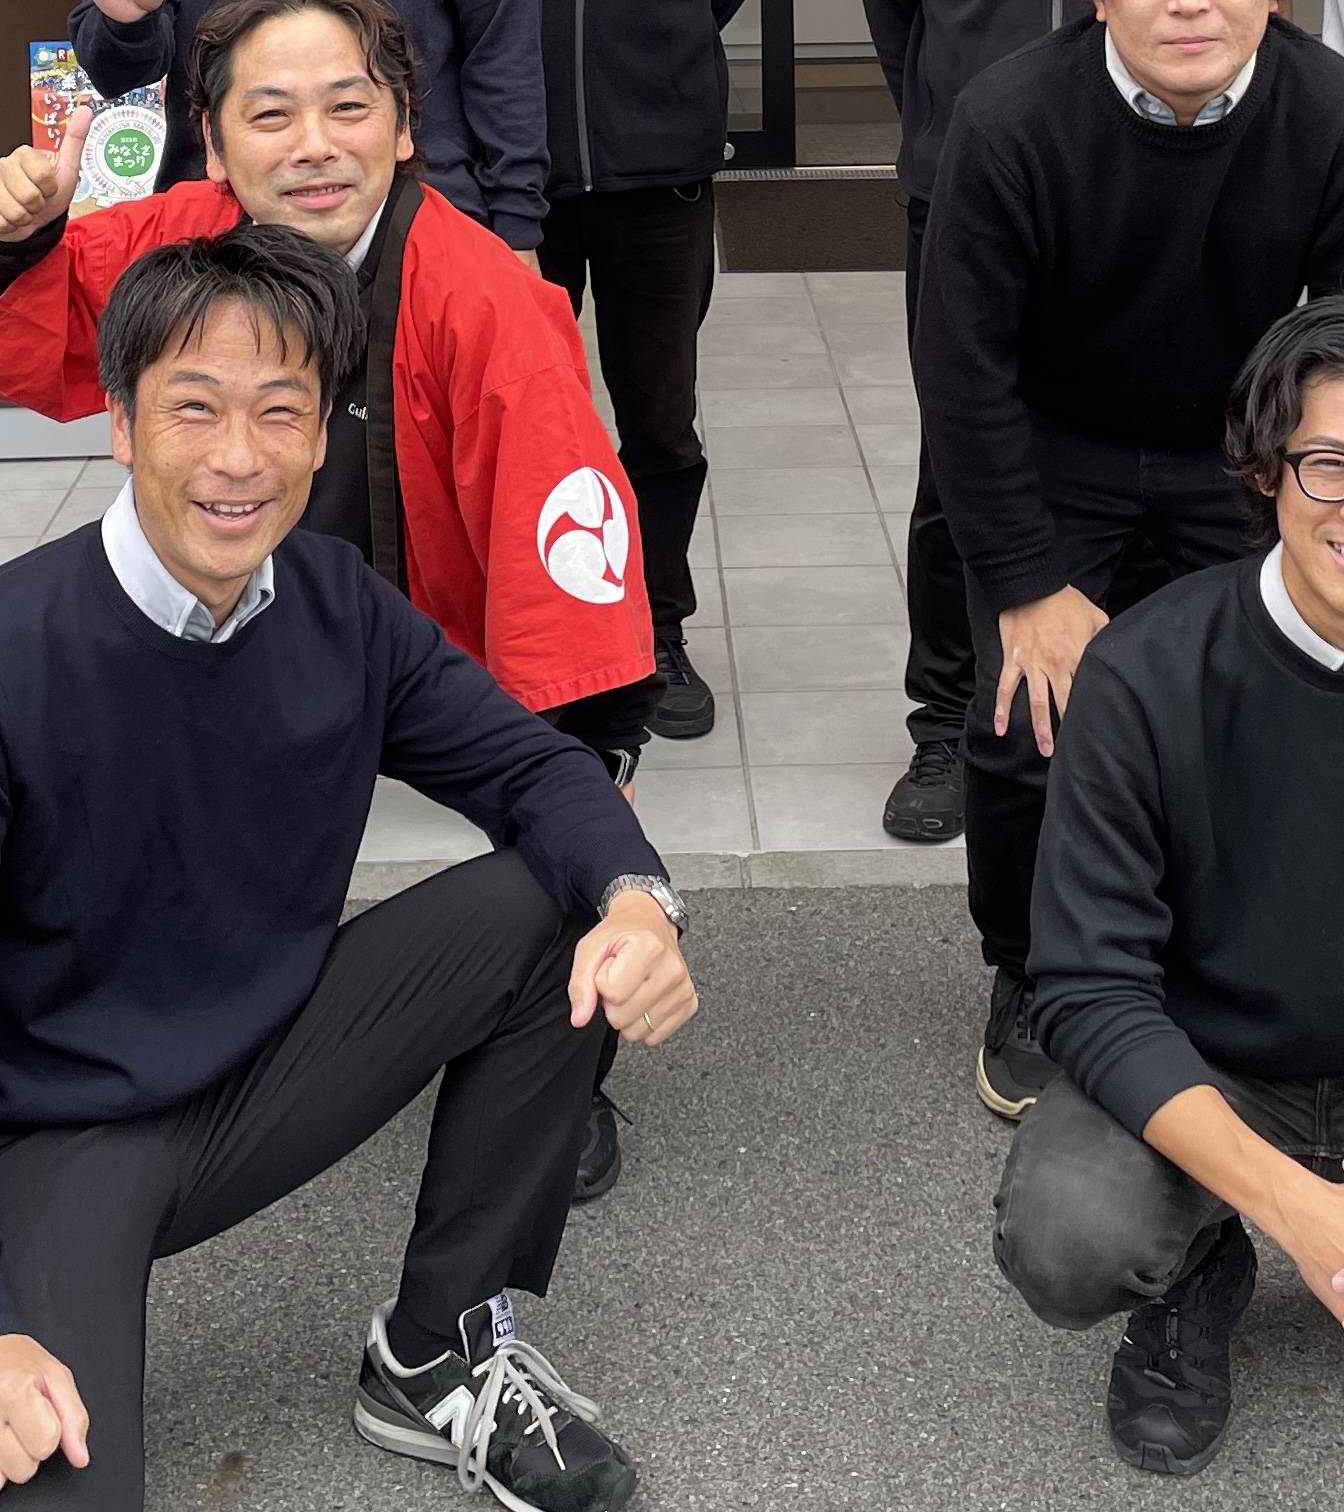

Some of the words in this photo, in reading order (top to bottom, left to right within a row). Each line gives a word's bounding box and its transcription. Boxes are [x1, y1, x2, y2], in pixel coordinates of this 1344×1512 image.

[108, 142, 151, 157] みなくさ
[113, 155, 146, 169] まつり
